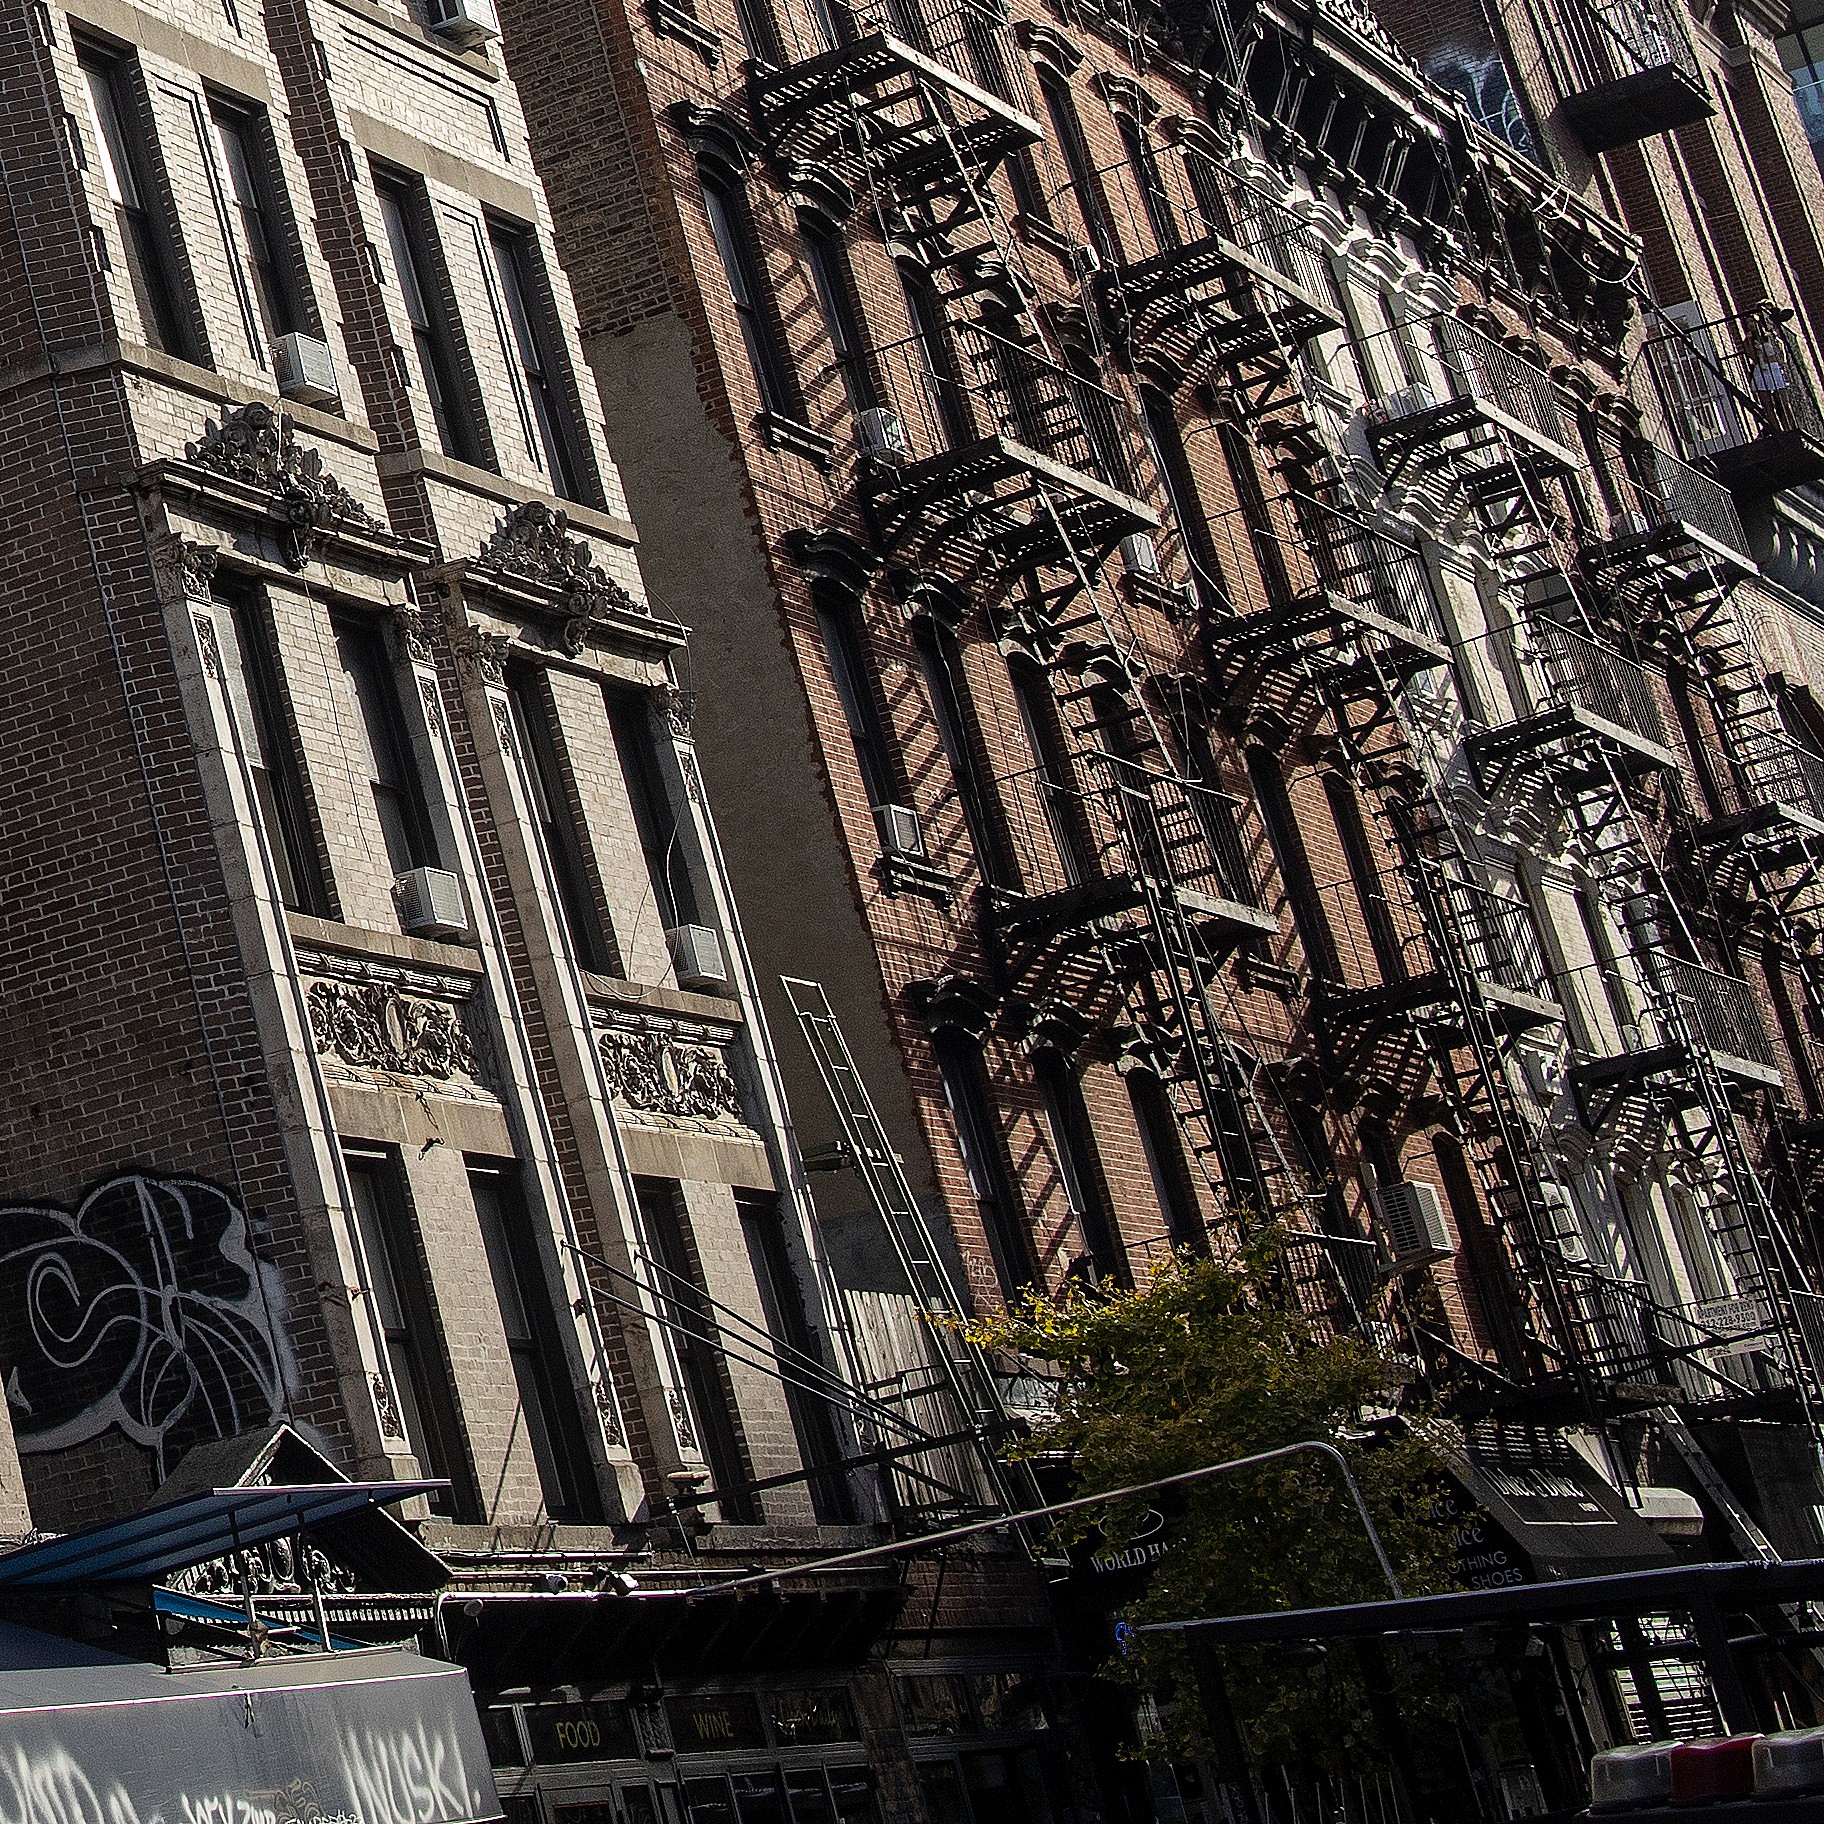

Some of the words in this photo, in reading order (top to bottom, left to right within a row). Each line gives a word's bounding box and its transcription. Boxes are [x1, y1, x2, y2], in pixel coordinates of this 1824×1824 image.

[1089, 1546, 1148, 1574] WORLD
[1470, 1567, 1524, 1590] SHOES
[555, 1719, 601, 1750] FOOD
[692, 1708, 737, 1740] WINE
